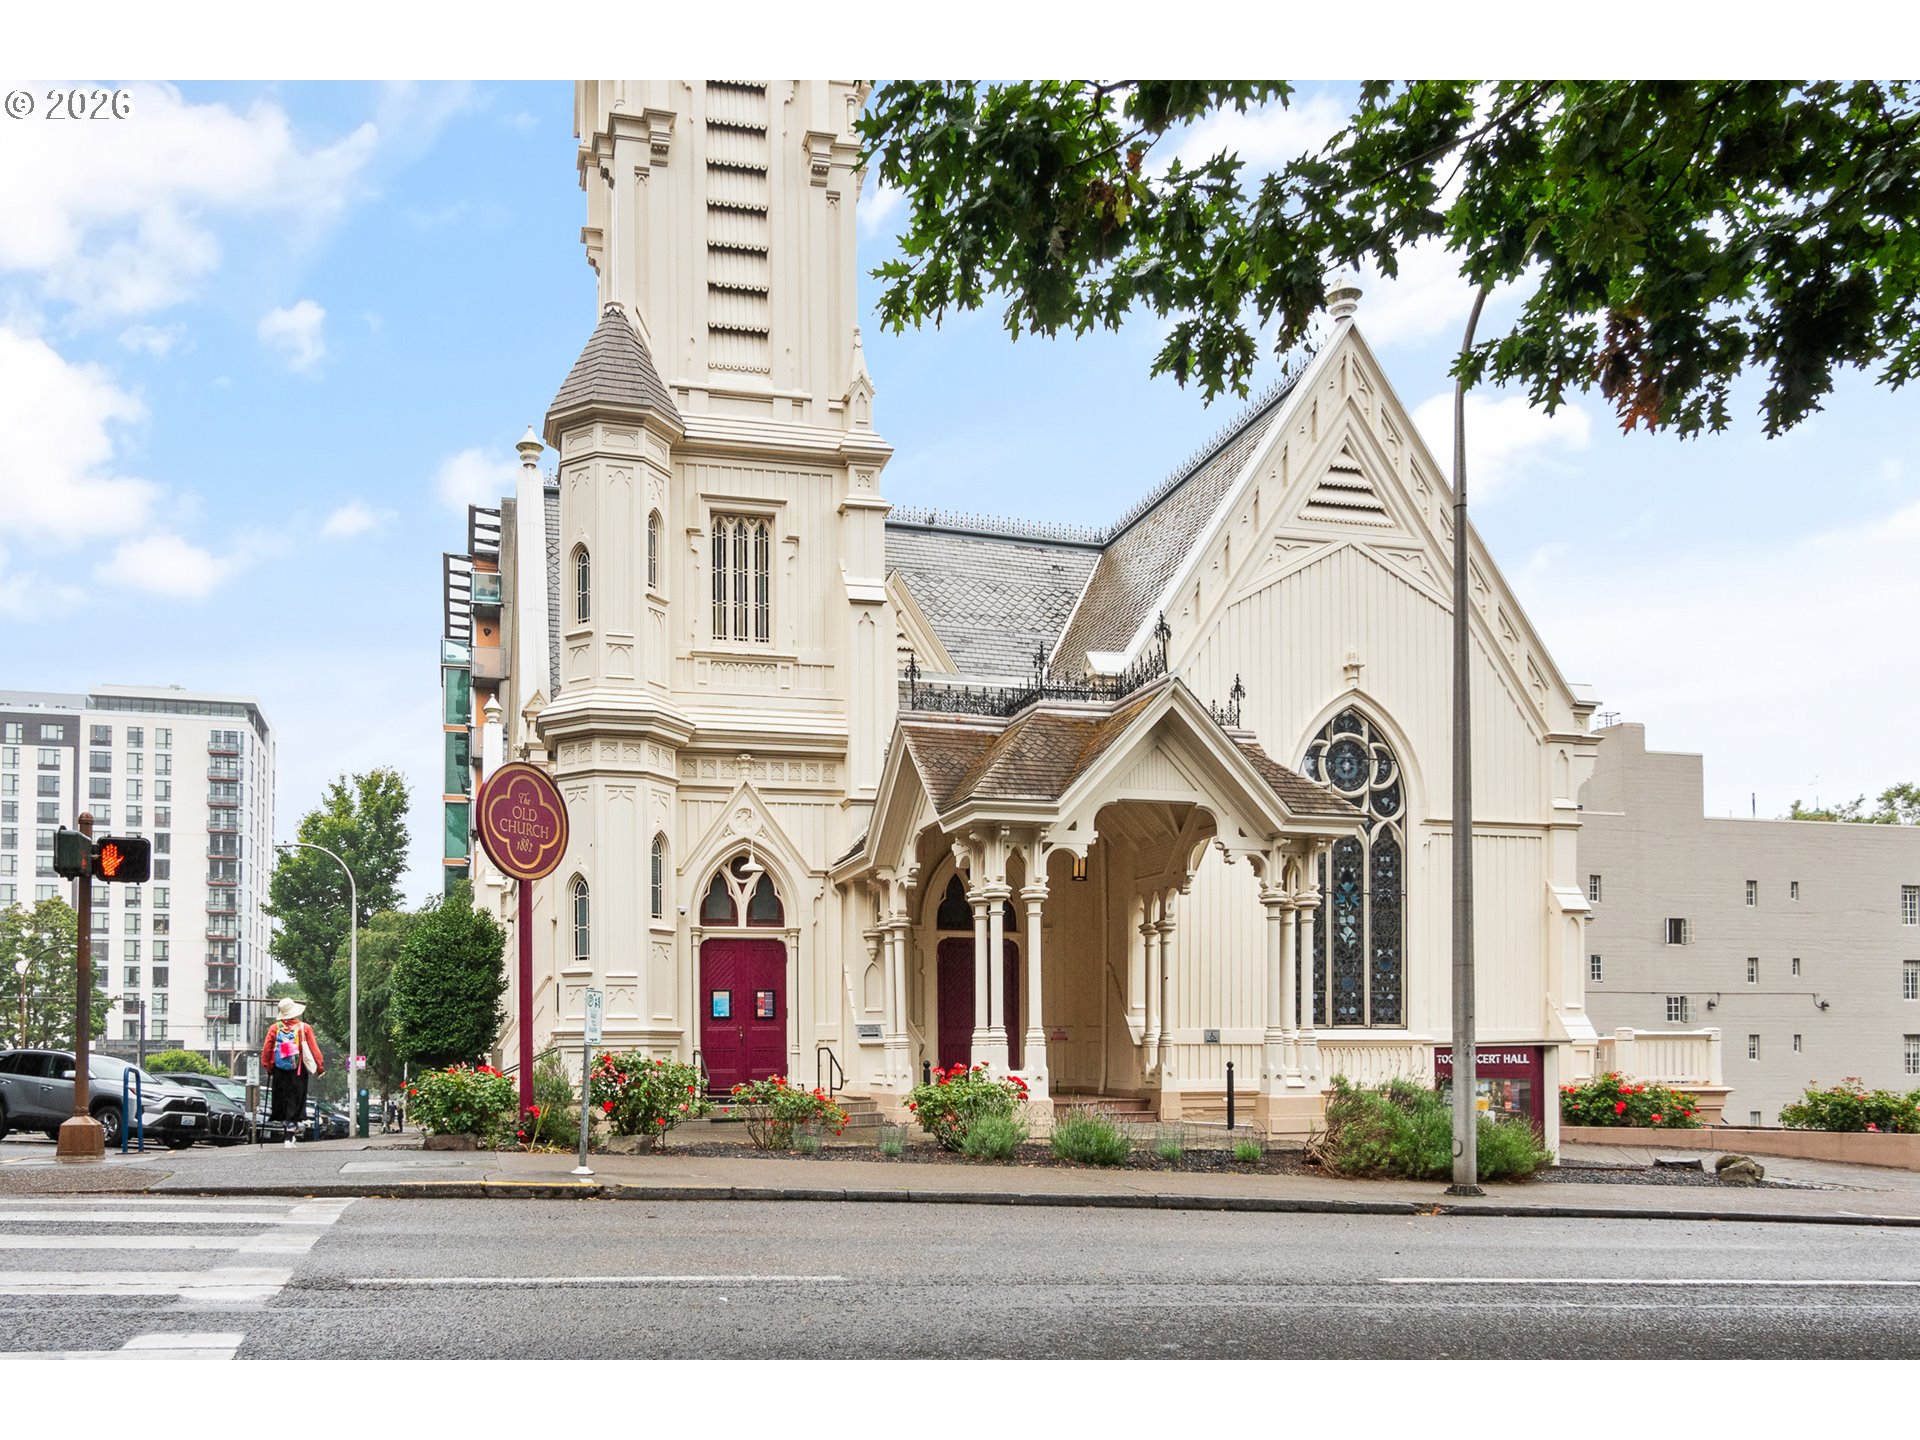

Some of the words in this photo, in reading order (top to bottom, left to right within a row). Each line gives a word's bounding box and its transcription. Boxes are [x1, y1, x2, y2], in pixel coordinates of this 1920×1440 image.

[518, 792, 530, 805] The
[512, 805, 537, 822] OLD
[500, 818, 549, 839] CHURCH
[516, 837, 533, 852] 1882
[1476, 1054, 1502, 1064] CERT
[1503, 1054, 1530, 1064] HALL
